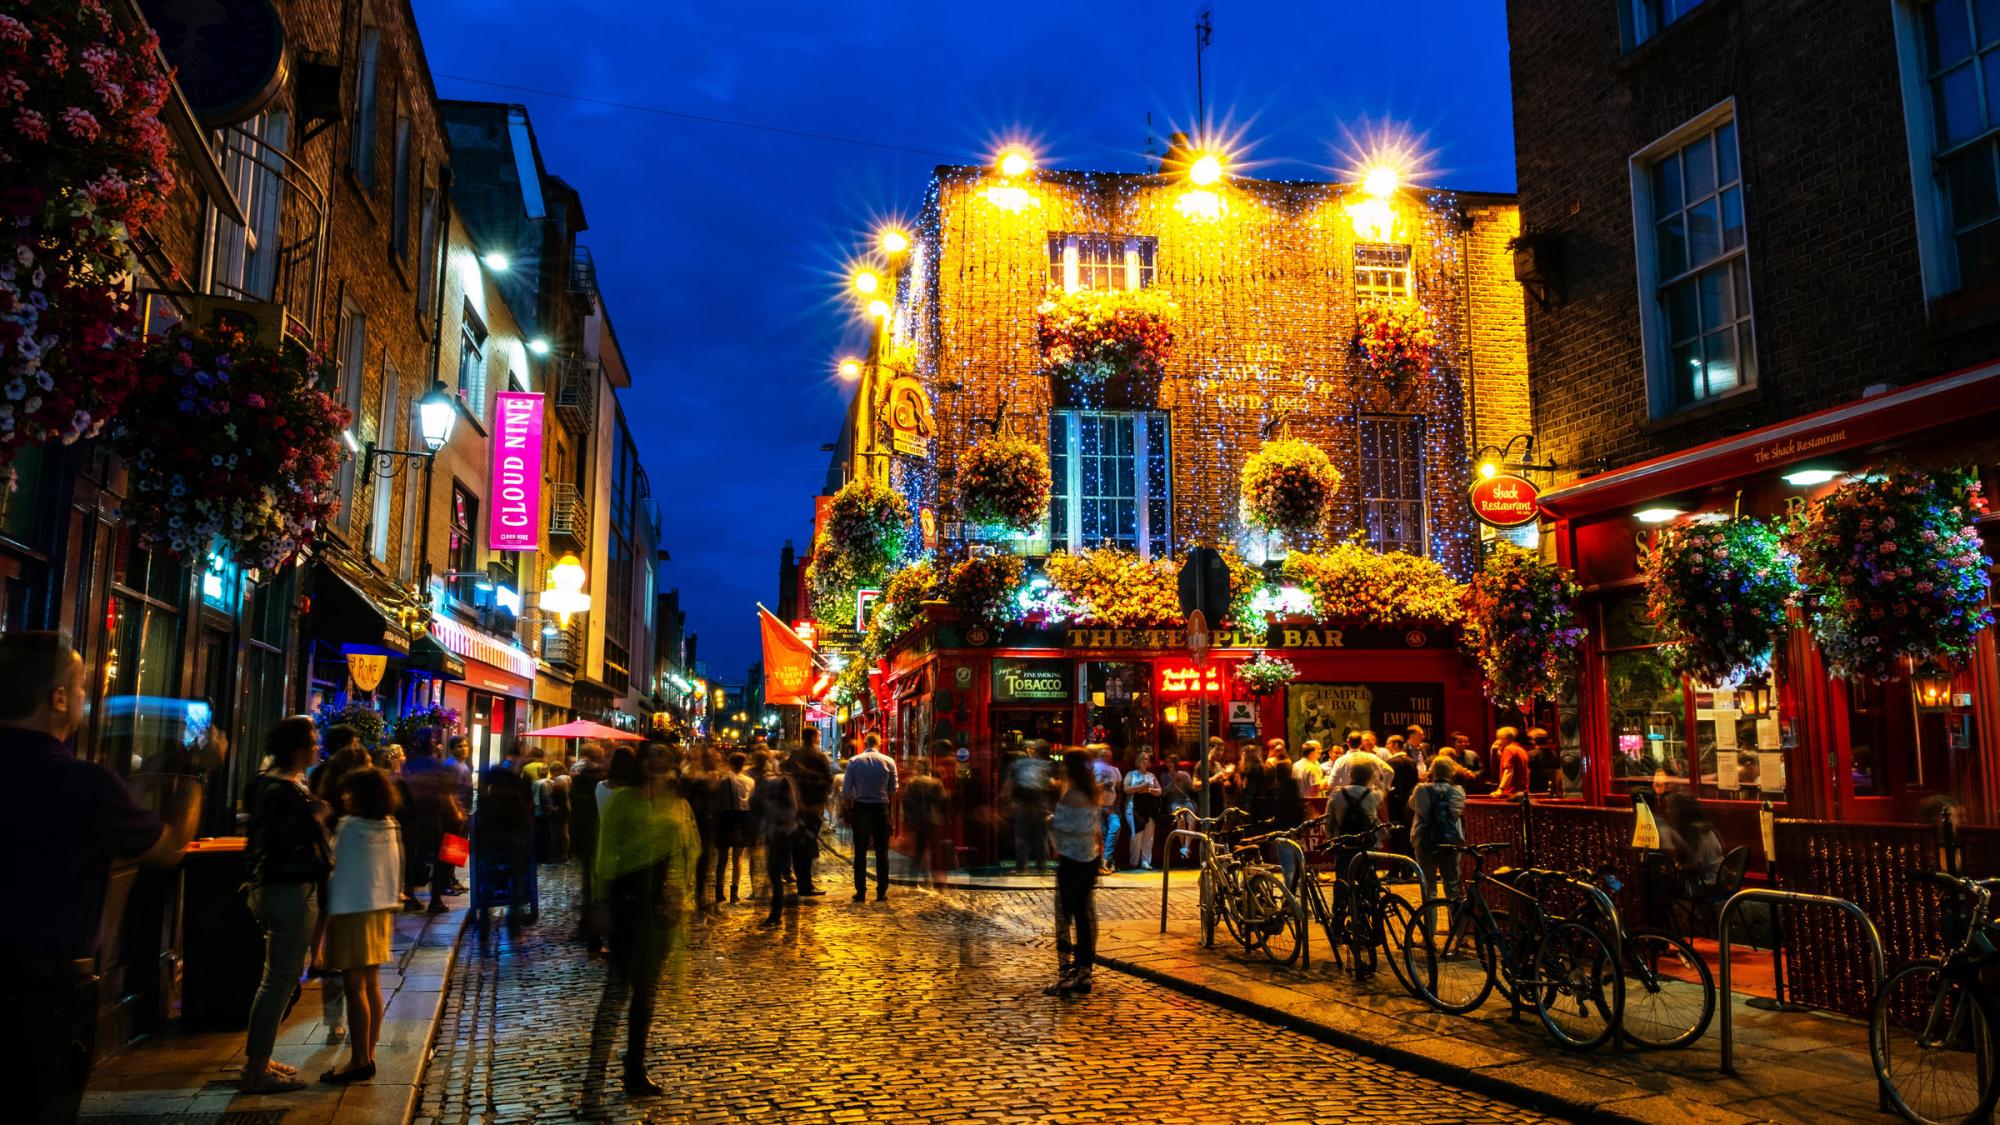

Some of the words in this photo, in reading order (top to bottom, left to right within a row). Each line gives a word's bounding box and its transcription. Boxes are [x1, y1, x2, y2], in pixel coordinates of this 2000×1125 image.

[505, 398, 534, 449] NINE
[1753, 447, 1769, 463] The
[1771, 439, 1795, 459] Shack
[1796, 430, 1847, 452] Restaurant
[501, 456, 528, 527] CLOUD
[1493, 483, 1519, 500] Shack
[1481, 501, 1532, 511] Restaurant
[1067, 629, 1133, 647] THE
[1148, 629, 1269, 648] TEPLE
[1283, 630, 1345, 648] BAR
[774, 671, 809, 679] TEMPLE
[1162, 666, 1216, 679] Traditioal
[783, 678, 802, 687] BAR
[1162, 679, 1187, 691] Irish
[1315, 689, 1367, 700] TEMPLE
[1331, 700, 1358, 711] BAR
[1410, 697, 1433, 711] THE
